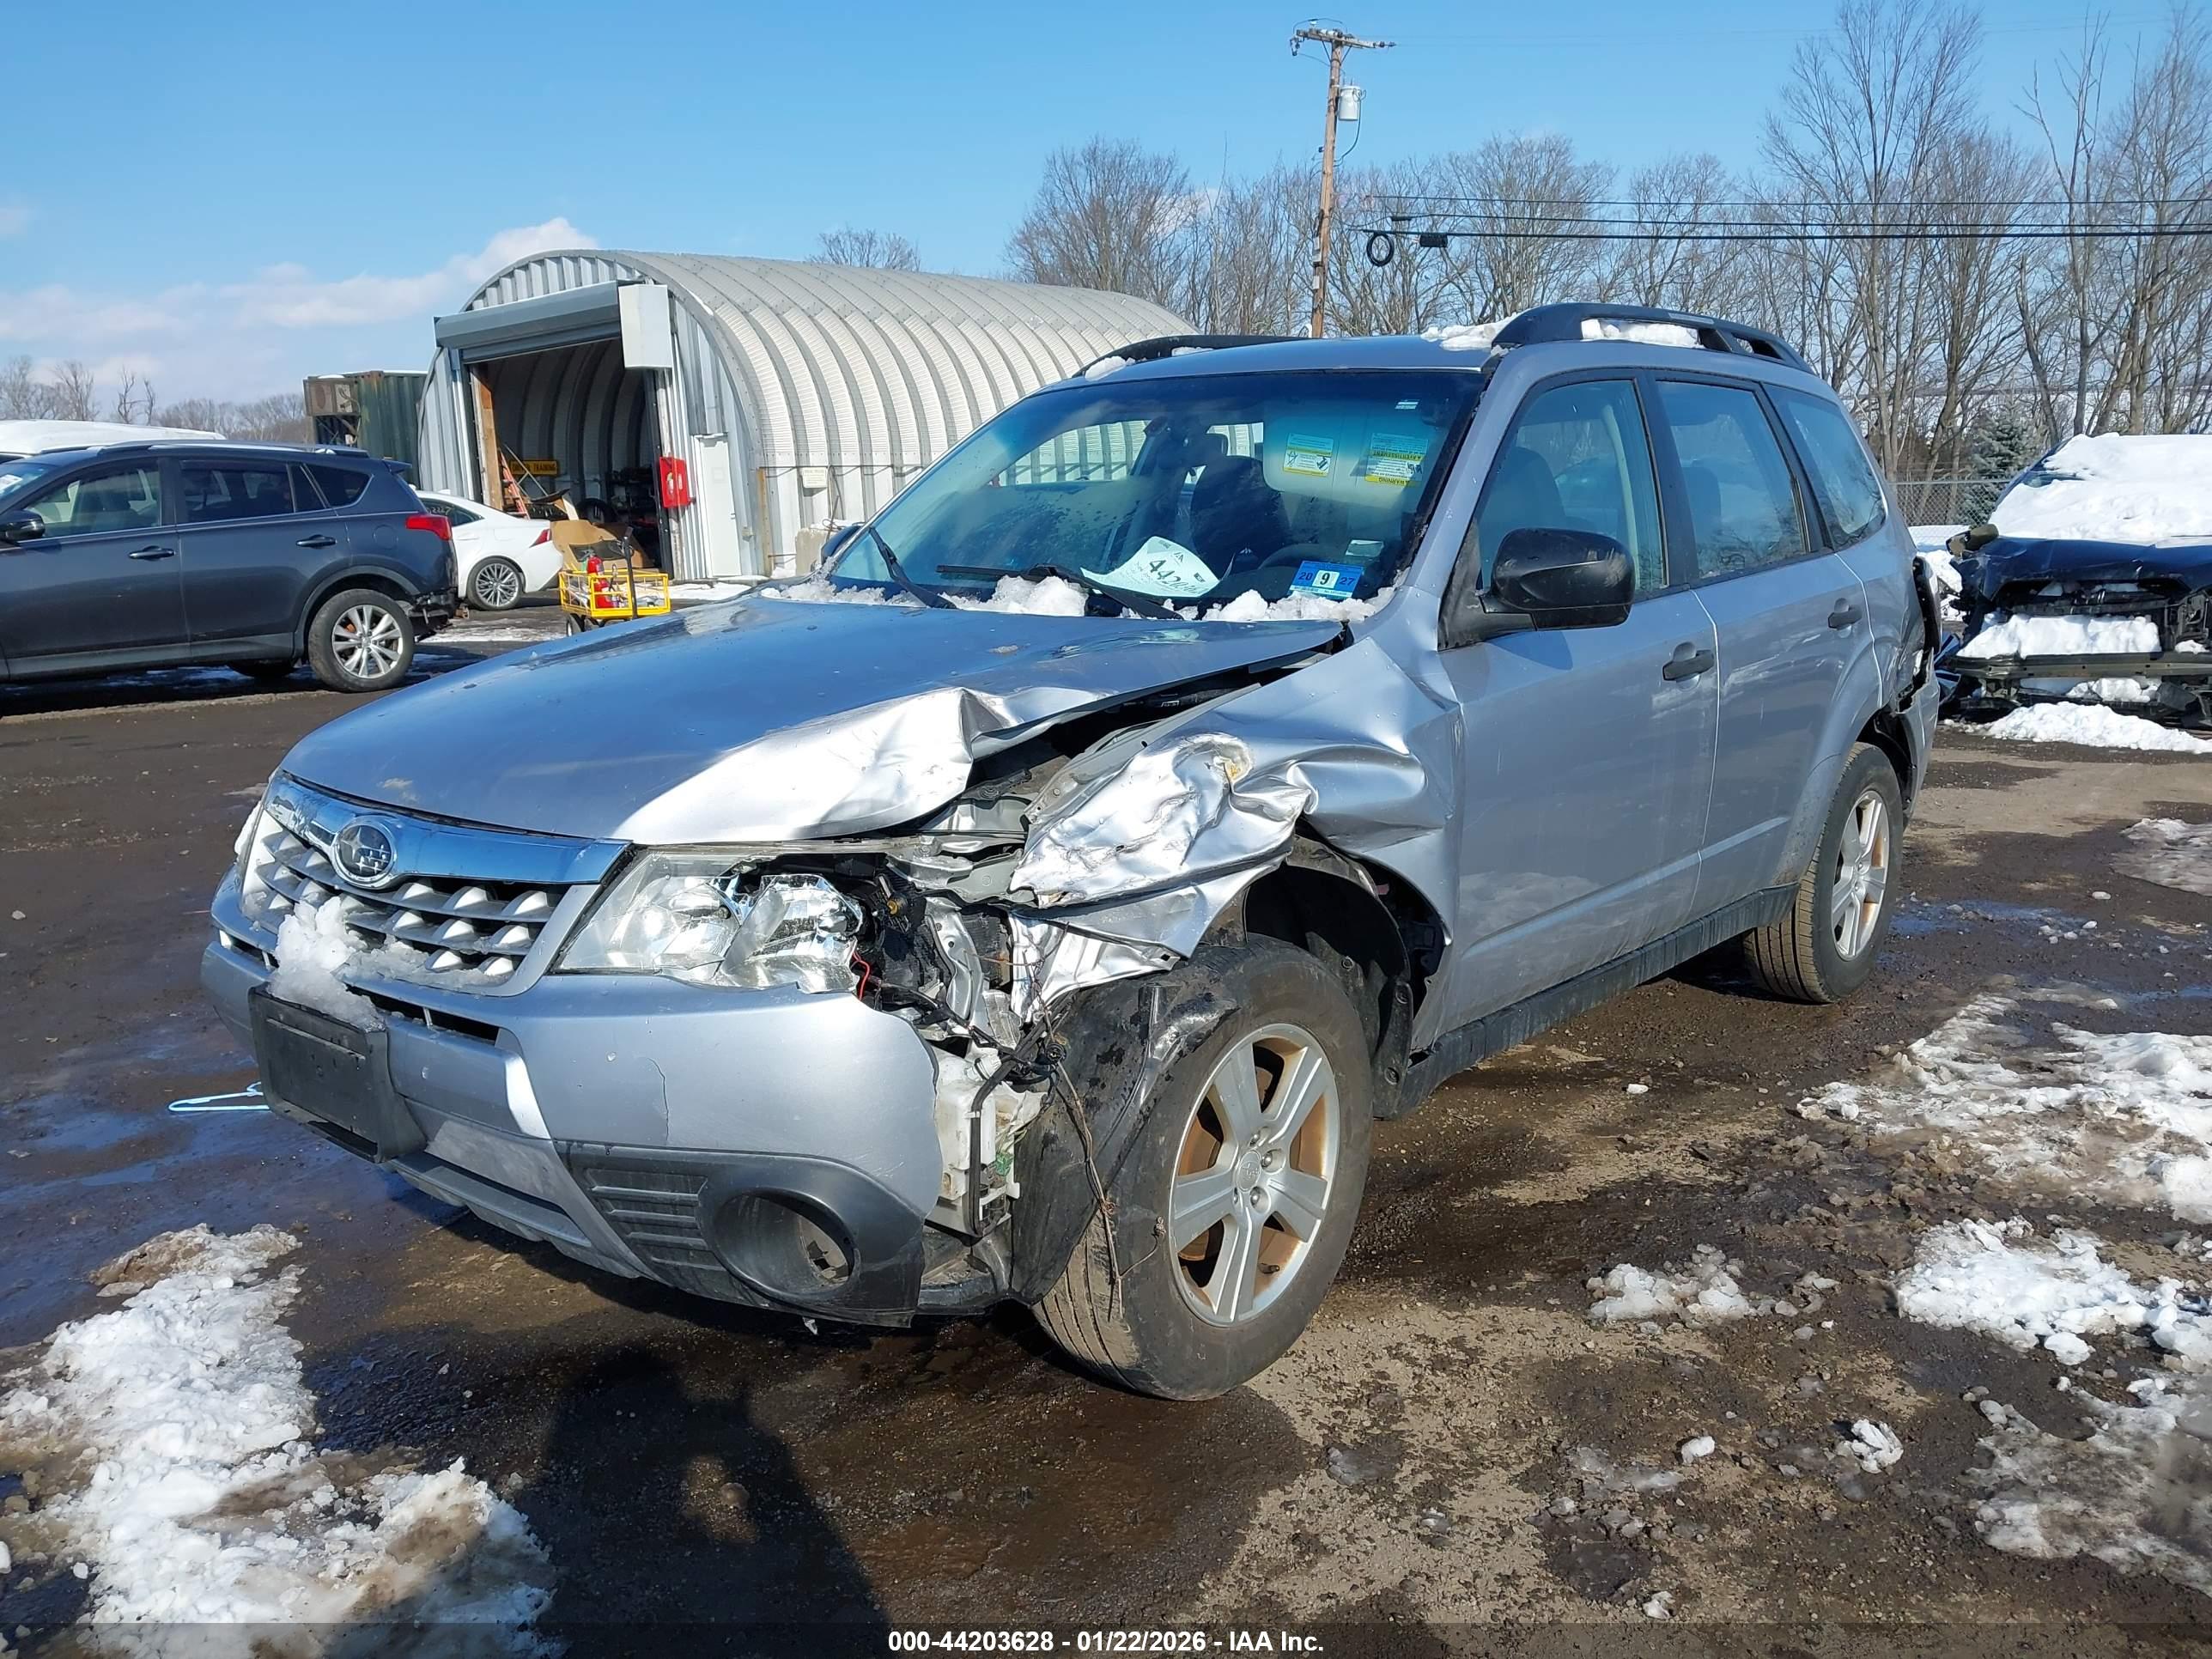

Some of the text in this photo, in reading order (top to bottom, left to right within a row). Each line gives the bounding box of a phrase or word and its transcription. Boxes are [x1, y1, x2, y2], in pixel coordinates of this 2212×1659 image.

[1378, 477, 1406, 486] WARNING
[1298, 572, 1355, 586] 20 9 27
